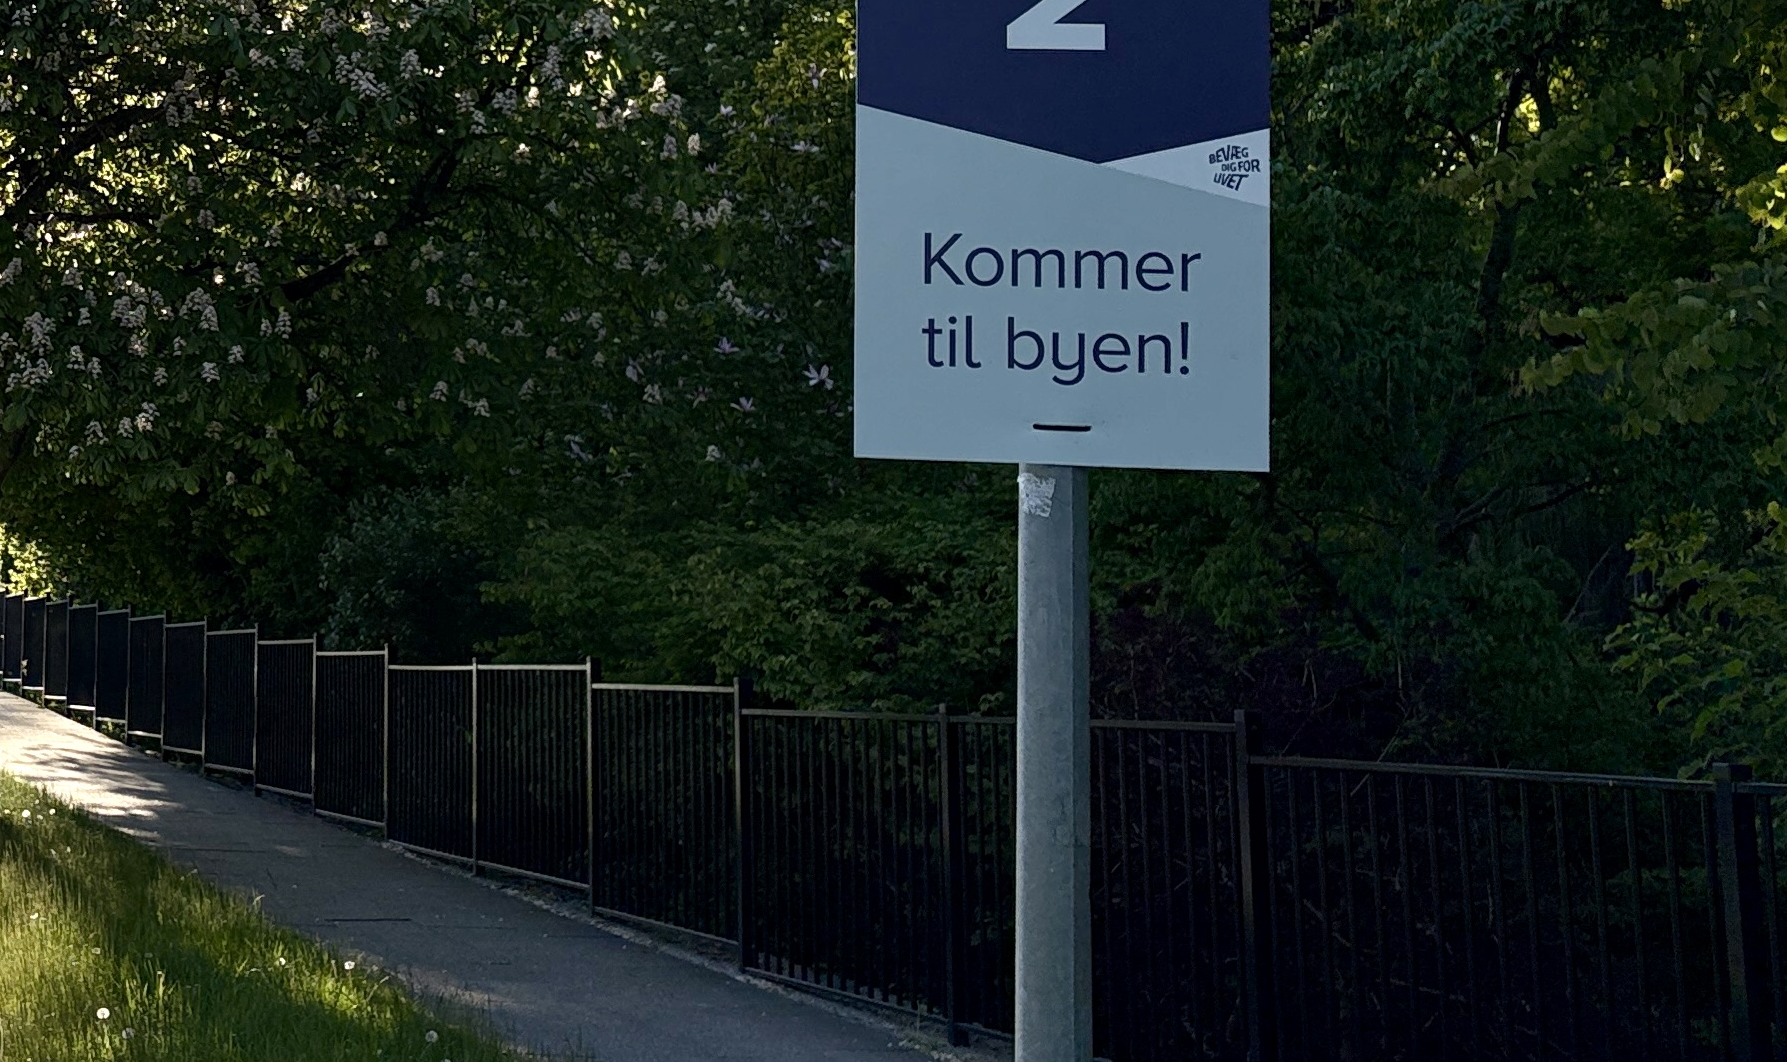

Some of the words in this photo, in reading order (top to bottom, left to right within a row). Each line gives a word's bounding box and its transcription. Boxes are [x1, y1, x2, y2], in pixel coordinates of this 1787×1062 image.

[1209, 144, 1249, 164] BEVÆG
[1221, 162, 1237, 173] DIG
[1238, 159, 1261, 173] FOR
[923, 232, 1202, 292] Kommer
[922, 315, 982, 369] til
[1007, 316, 1190, 386] byen!
